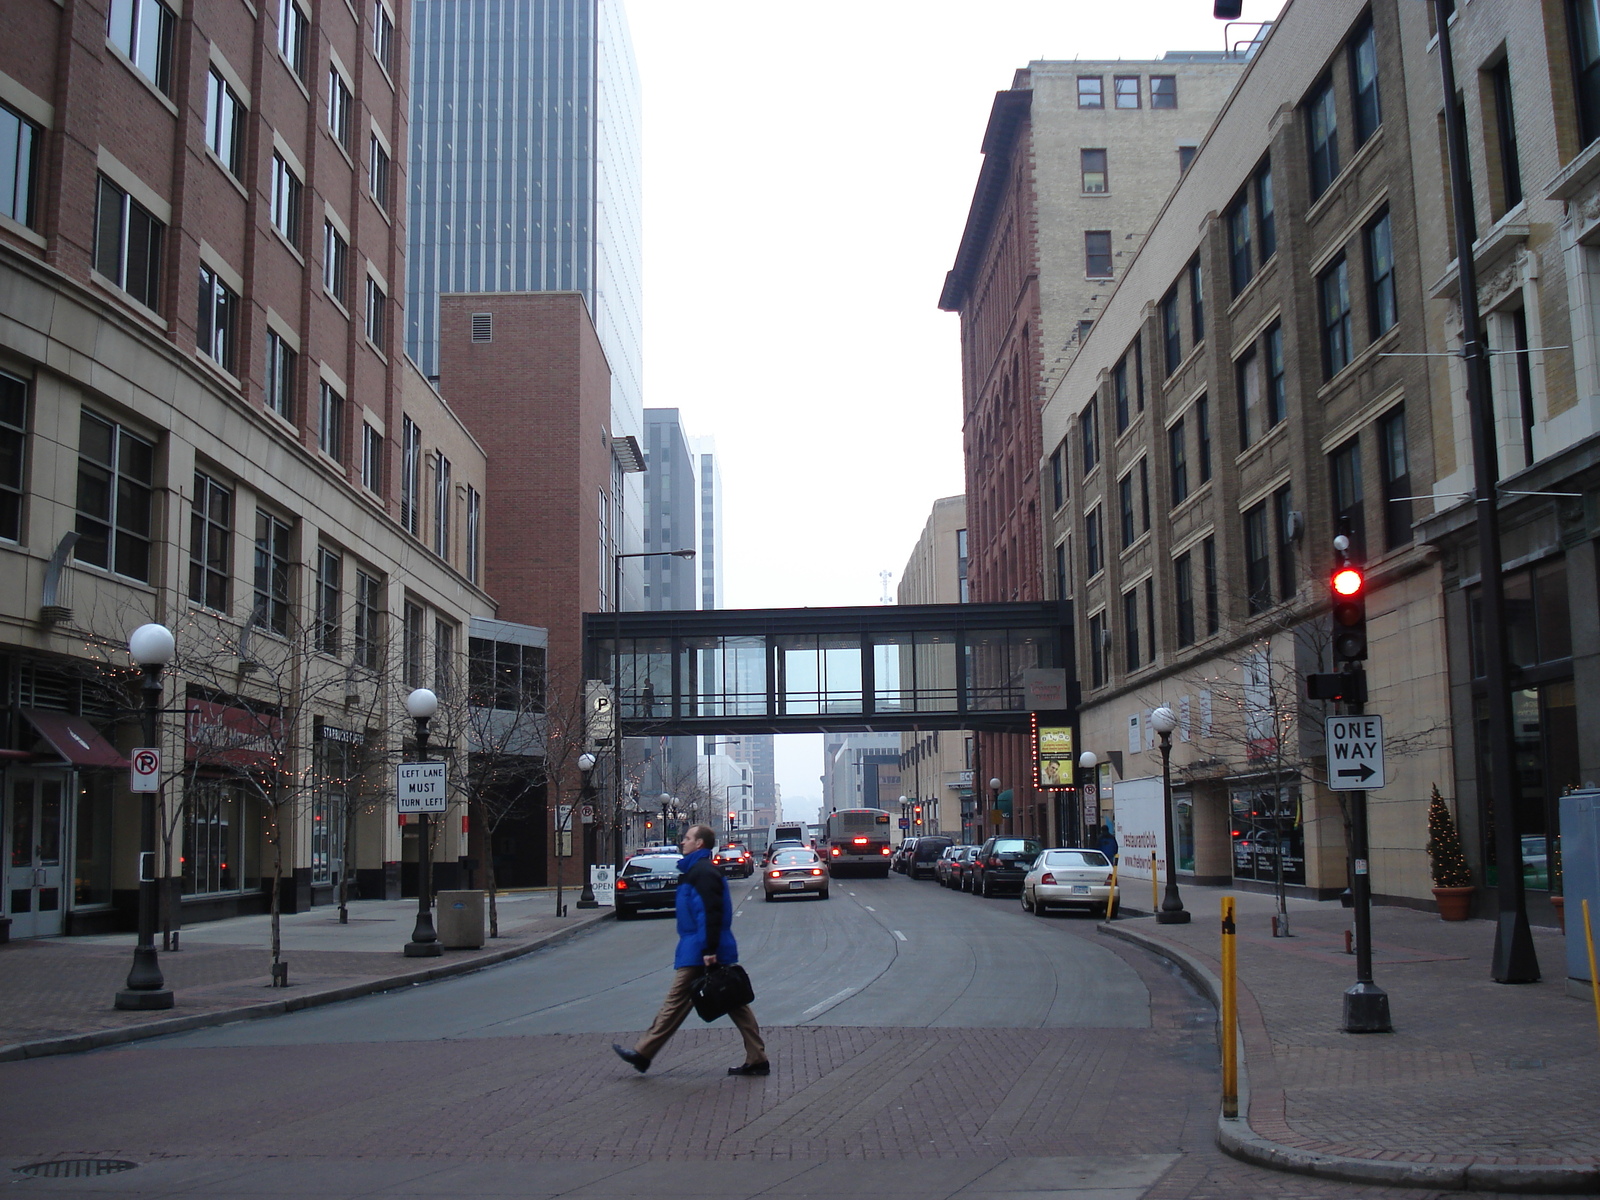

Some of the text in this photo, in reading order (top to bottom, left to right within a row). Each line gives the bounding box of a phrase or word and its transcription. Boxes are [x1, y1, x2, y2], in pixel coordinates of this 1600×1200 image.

[599, 698, 607, 710] P
[1334, 722, 1376, 739] ONE
[1334, 742, 1377, 759] WAY
[401, 769, 443, 778] LEFT LANE
[409, 783, 435, 793] MUST
[425, 798, 443, 806] LEFT
[592, 882, 613, 890] OPEN
